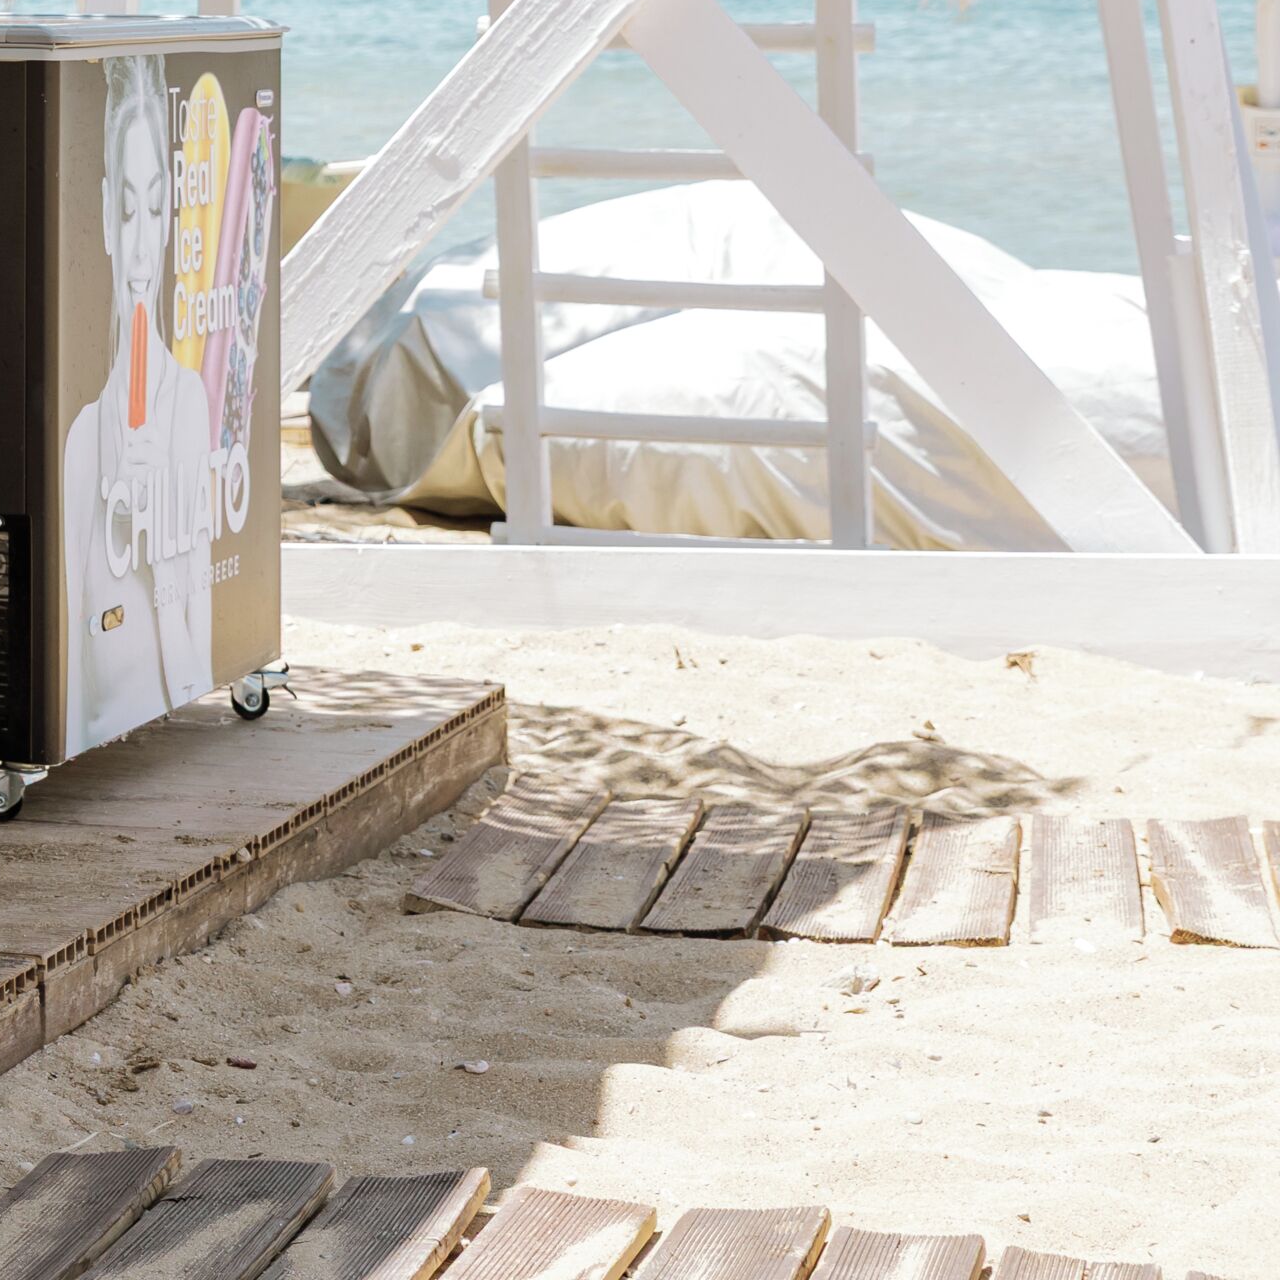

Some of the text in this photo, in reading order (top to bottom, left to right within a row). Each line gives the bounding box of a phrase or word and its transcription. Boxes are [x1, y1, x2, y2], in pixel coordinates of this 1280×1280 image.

[169, 87, 218, 144] Taste
[173, 144, 215, 210] Real
[173, 217, 203, 275] Ice
[173, 281, 236, 341] Cream
[101, 442, 250, 578] CHILLATO
[201, 555, 241, 591] GREECE
